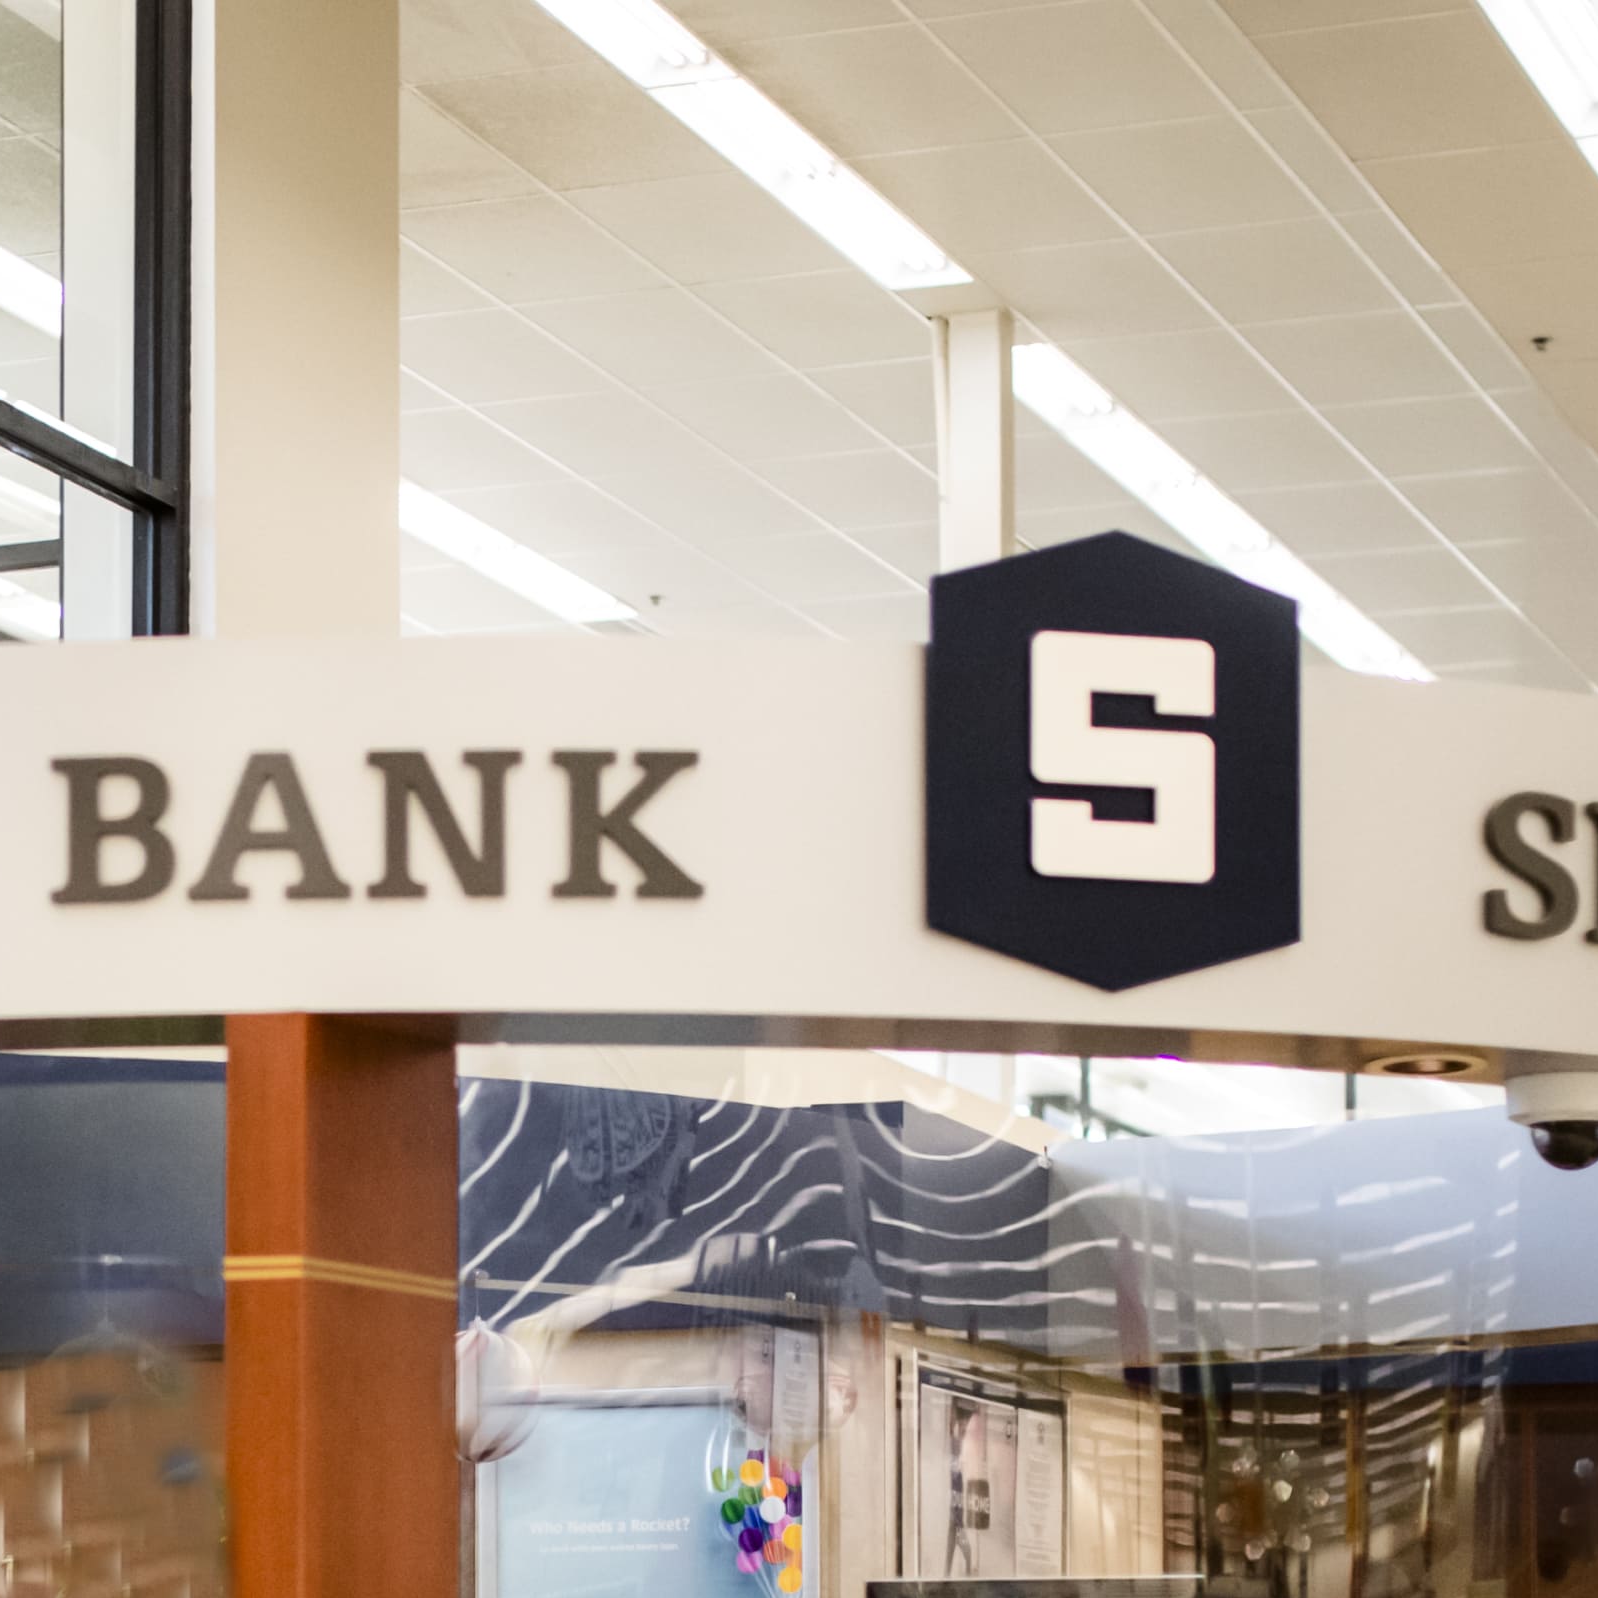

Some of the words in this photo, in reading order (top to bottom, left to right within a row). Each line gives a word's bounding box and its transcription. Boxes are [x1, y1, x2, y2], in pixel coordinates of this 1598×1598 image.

[50, 750, 704, 904] BANK
[1030, 630, 1216, 884] S
[530, 1520, 563, 1535] Who
[567, 1519, 613, 1534] Needs
[631, 1517, 691, 1532] Rocket?
